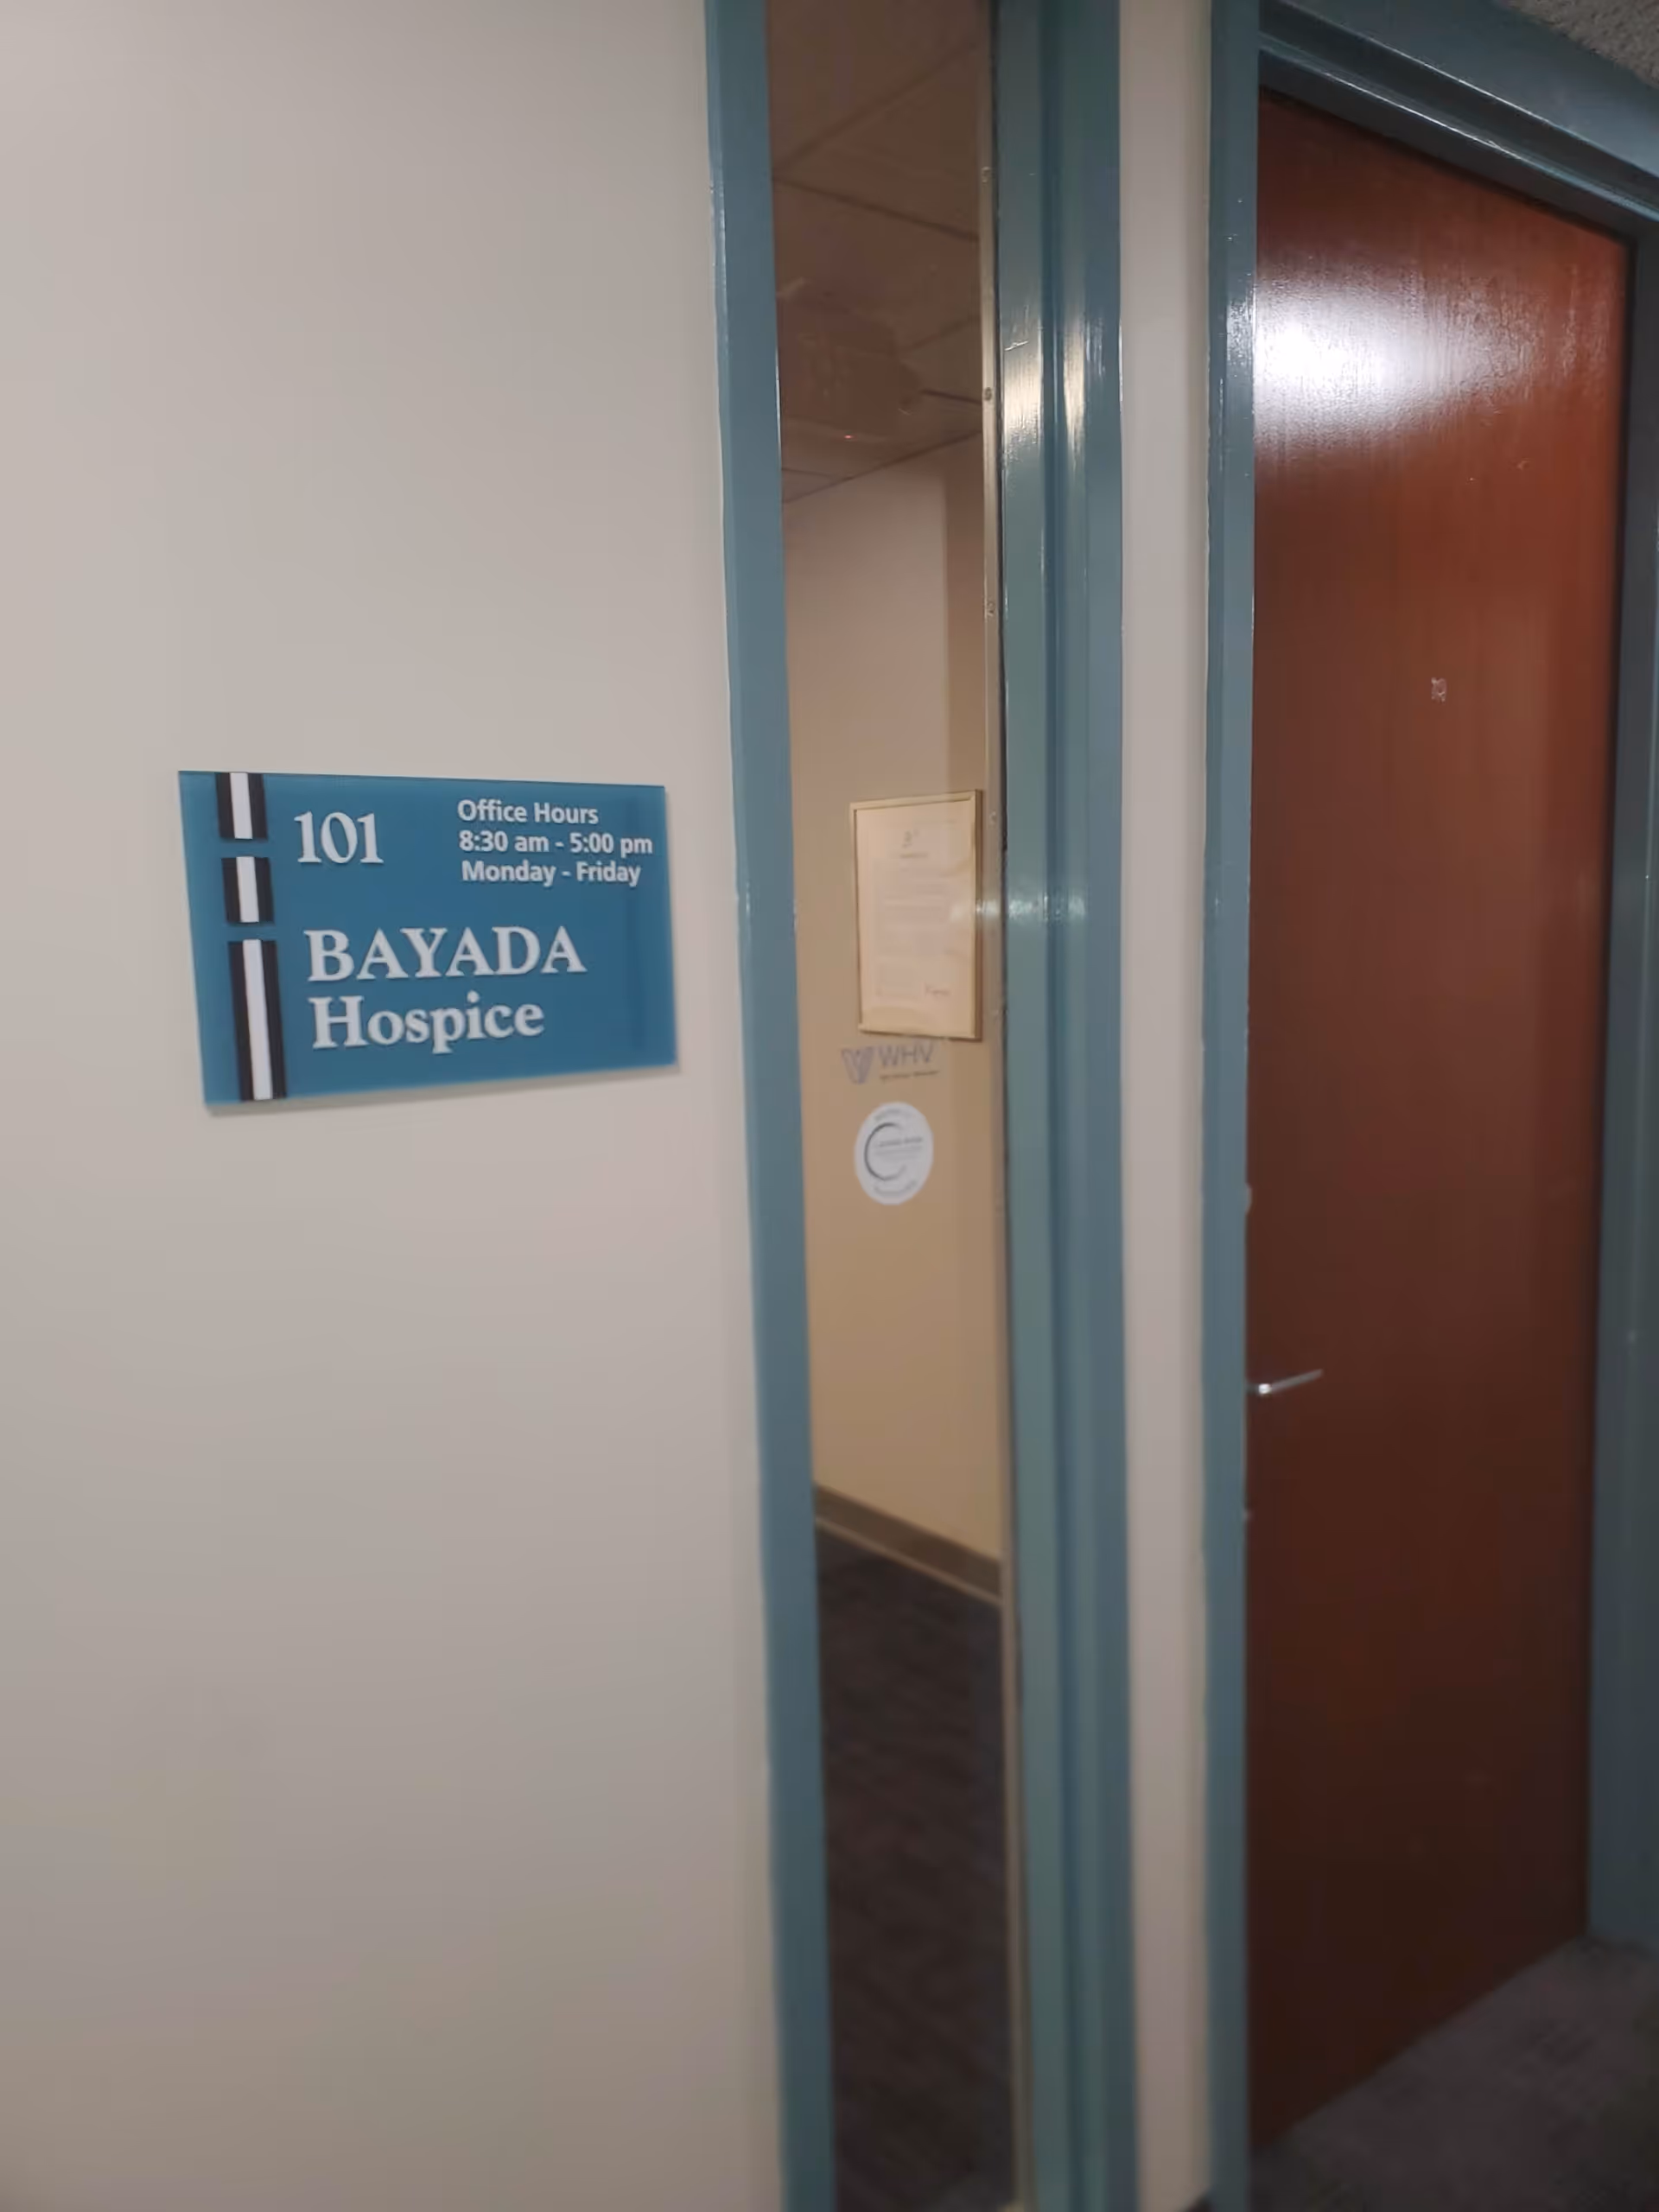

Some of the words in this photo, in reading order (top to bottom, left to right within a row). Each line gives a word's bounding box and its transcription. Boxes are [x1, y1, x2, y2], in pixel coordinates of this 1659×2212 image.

[457, 799, 527, 823] Office
[533, 802, 599, 824] Hours
[295, 810, 384, 865] 101
[459, 830, 508, 852] 8:30
[515, 836, 549, 852] am
[569, 832, 614, 854] 5:00
[620, 836, 653, 858] pm
[461, 861, 556, 887] Monday
[576, 861, 641, 887] Friday
[303, 925, 588, 982] BAYADA
[308, 990, 544, 1054] Hospice
